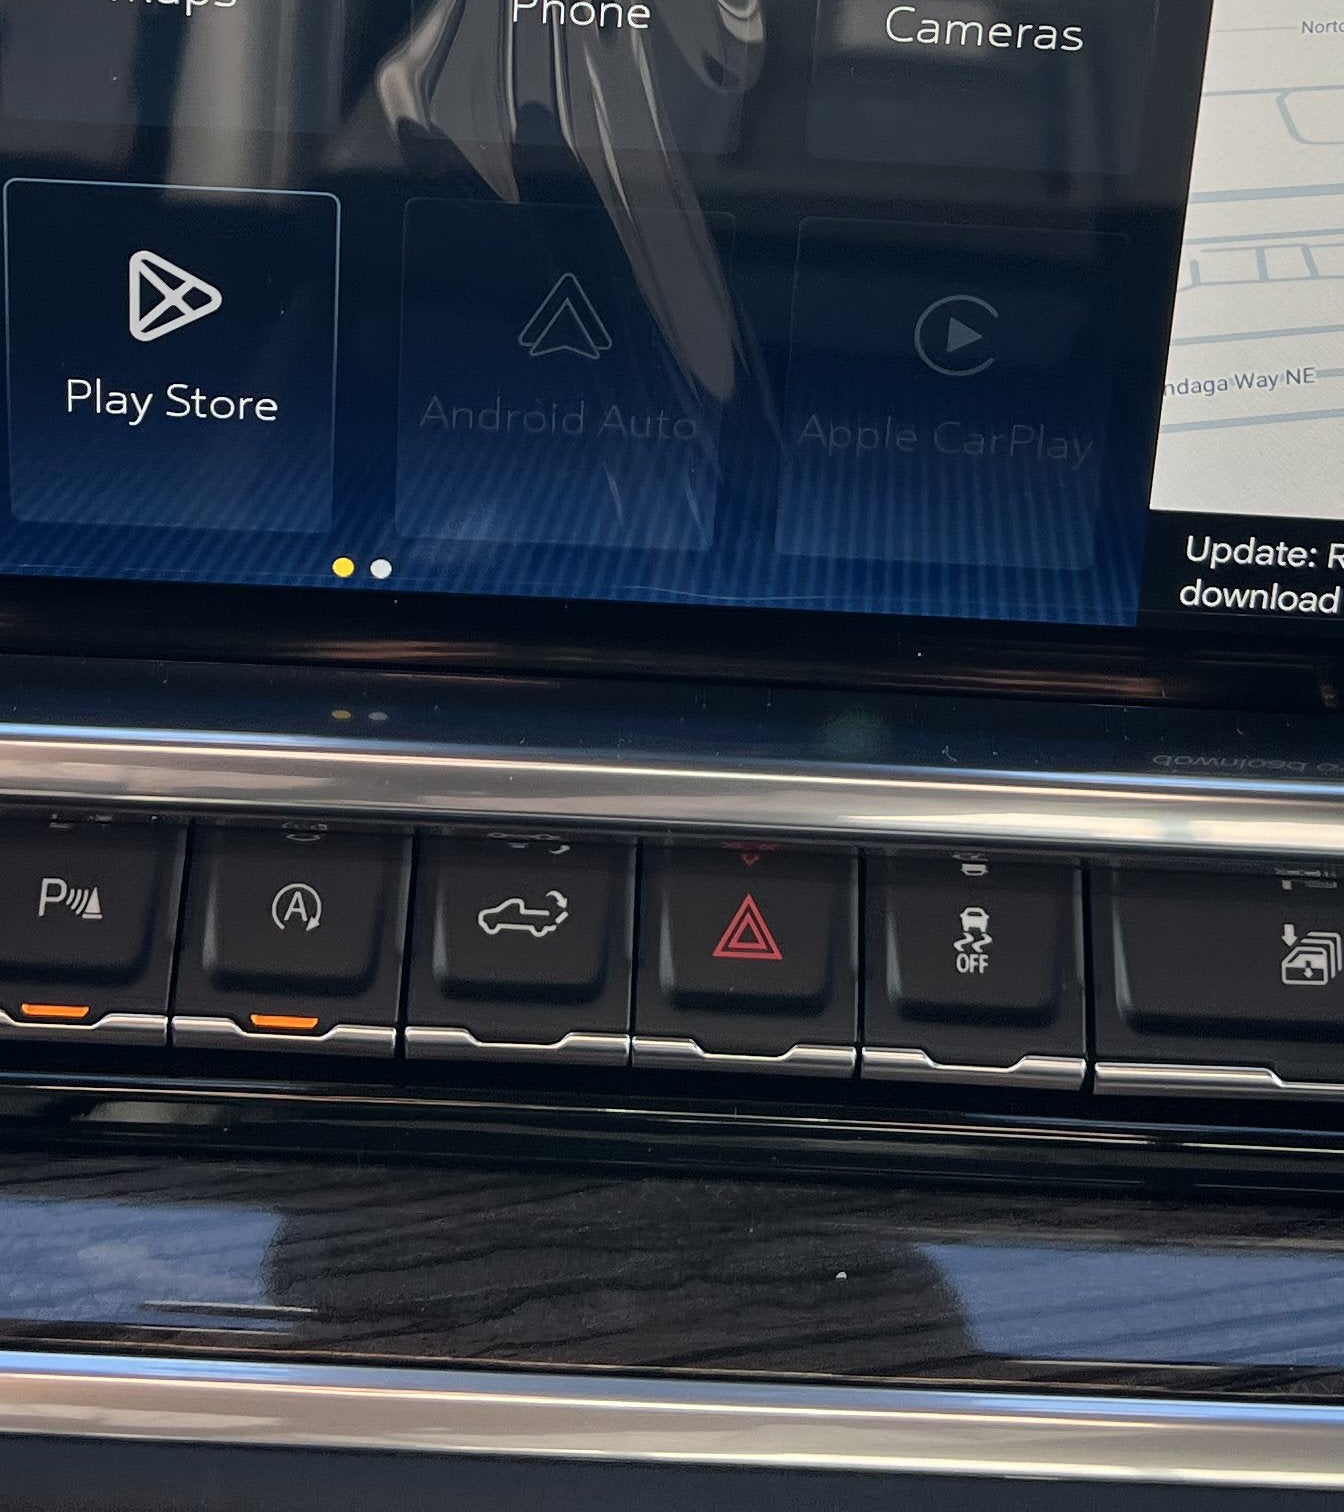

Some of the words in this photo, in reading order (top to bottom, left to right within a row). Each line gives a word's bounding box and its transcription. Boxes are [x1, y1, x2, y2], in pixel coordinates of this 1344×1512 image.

[885, 4, 1084, 54] Cameras
[1234, 372, 1278, 393] Way
[1286, 367, 1316, 386] NE
[66, 377, 154, 428] Play
[165, 382, 279, 424] Store
[418, 392, 586, 439] Android
[597, 403, 698, 442] Auto
[796, 412, 919, 458] Apple
[931, 419, 1095, 465] CarPlay
[1186, 535, 1317, 570] Update:
[1179, 578, 1343, 615] download
[956, 952, 989, 974] OFF
